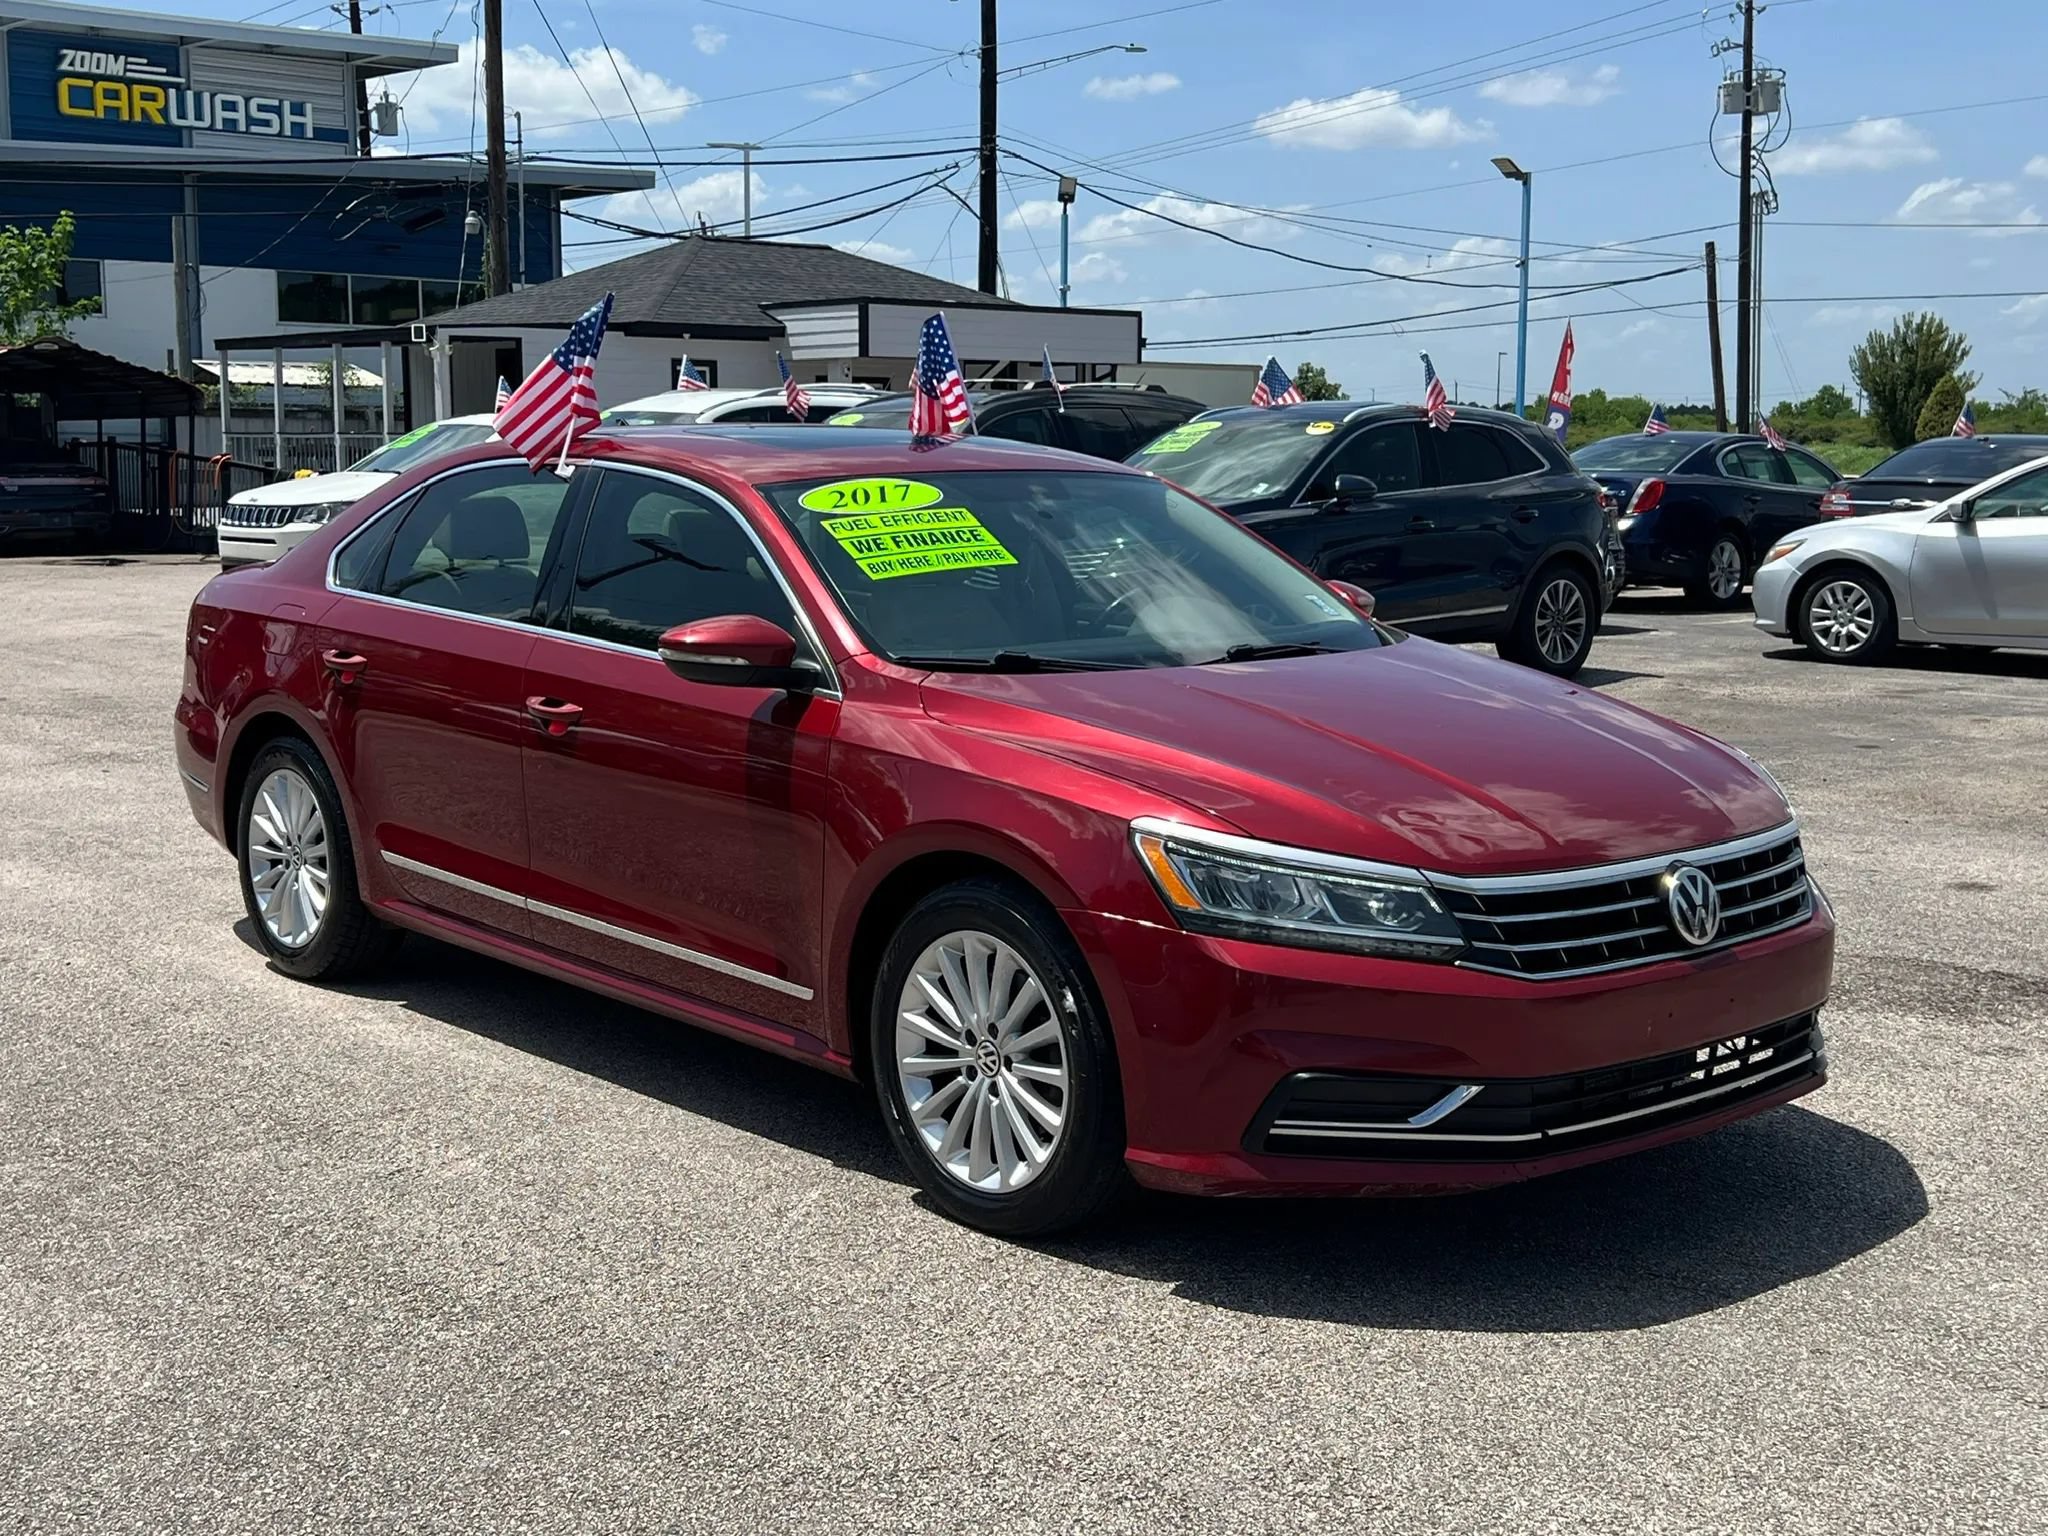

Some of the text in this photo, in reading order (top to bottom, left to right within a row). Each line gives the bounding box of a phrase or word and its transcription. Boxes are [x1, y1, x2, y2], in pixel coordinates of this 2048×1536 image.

[57, 48, 126, 76] ZOOM
[828, 484, 911, 509] 2017
[829, 511, 966, 534] FUEL EFFICIENT
[850, 529, 984, 553] WE FINANCE
[867, 560, 896, 575] BUY
[899, 554, 934, 571] HERE
[942, 551, 969, 564] PAY
[969, 549, 1005, 562] HERE
